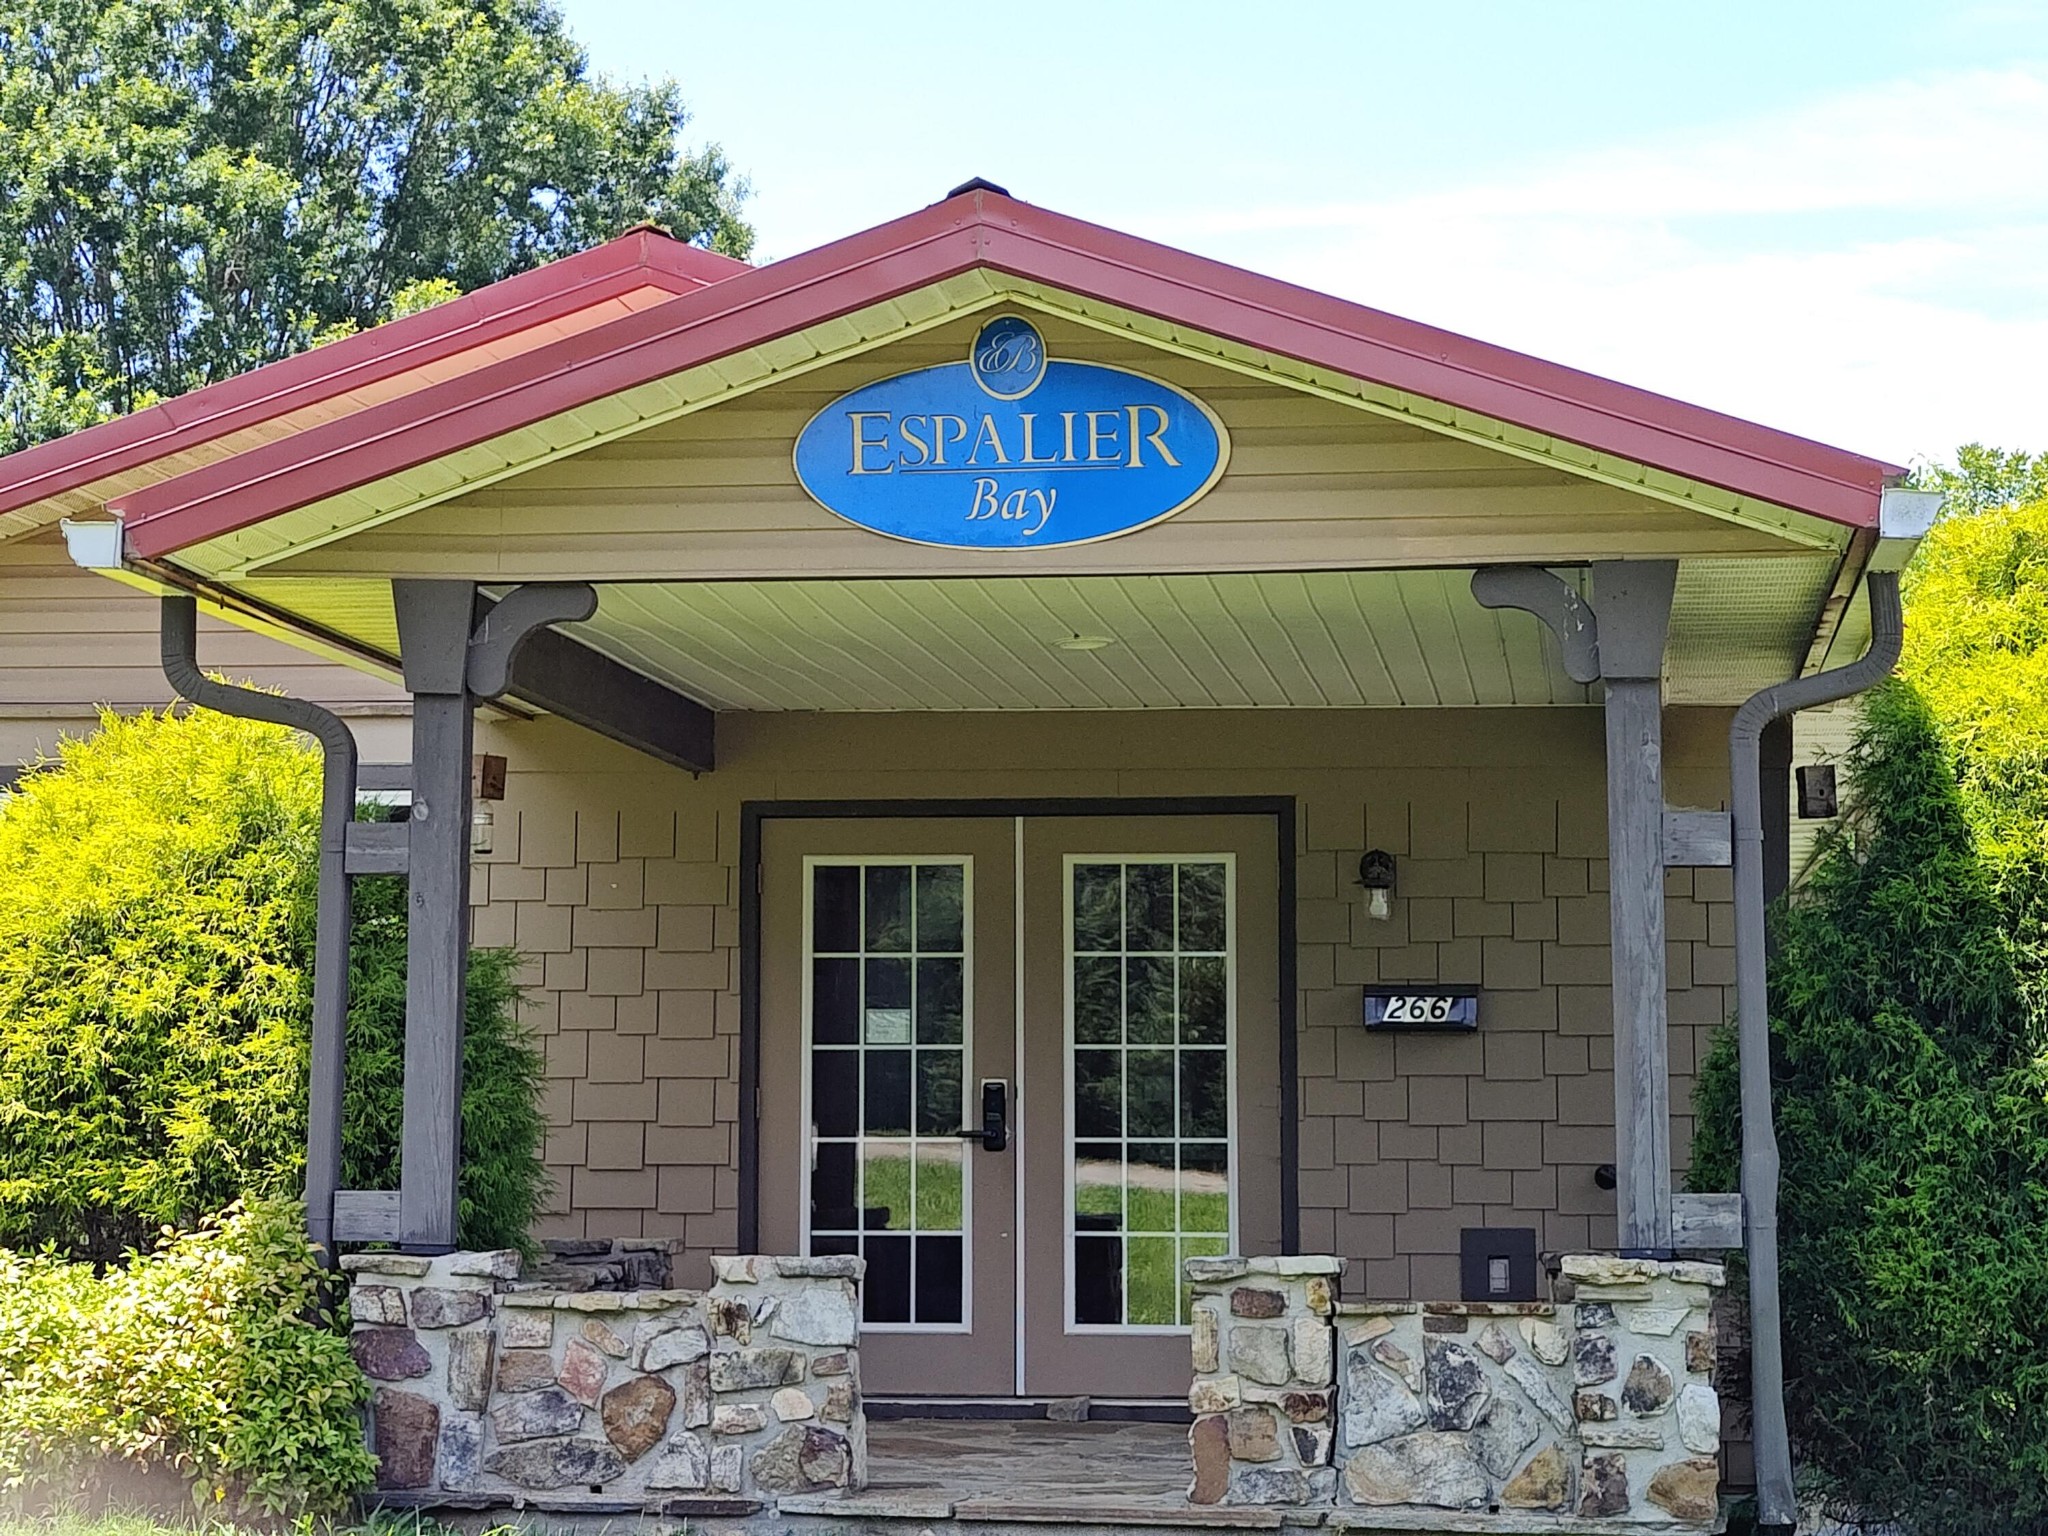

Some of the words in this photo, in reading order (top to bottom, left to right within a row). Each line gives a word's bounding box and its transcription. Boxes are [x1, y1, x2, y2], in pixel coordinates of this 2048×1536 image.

[846, 404, 1182, 476] ESPALIER
[965, 477, 1057, 536] Bay
[1387, 996, 1448, 1020] 266
